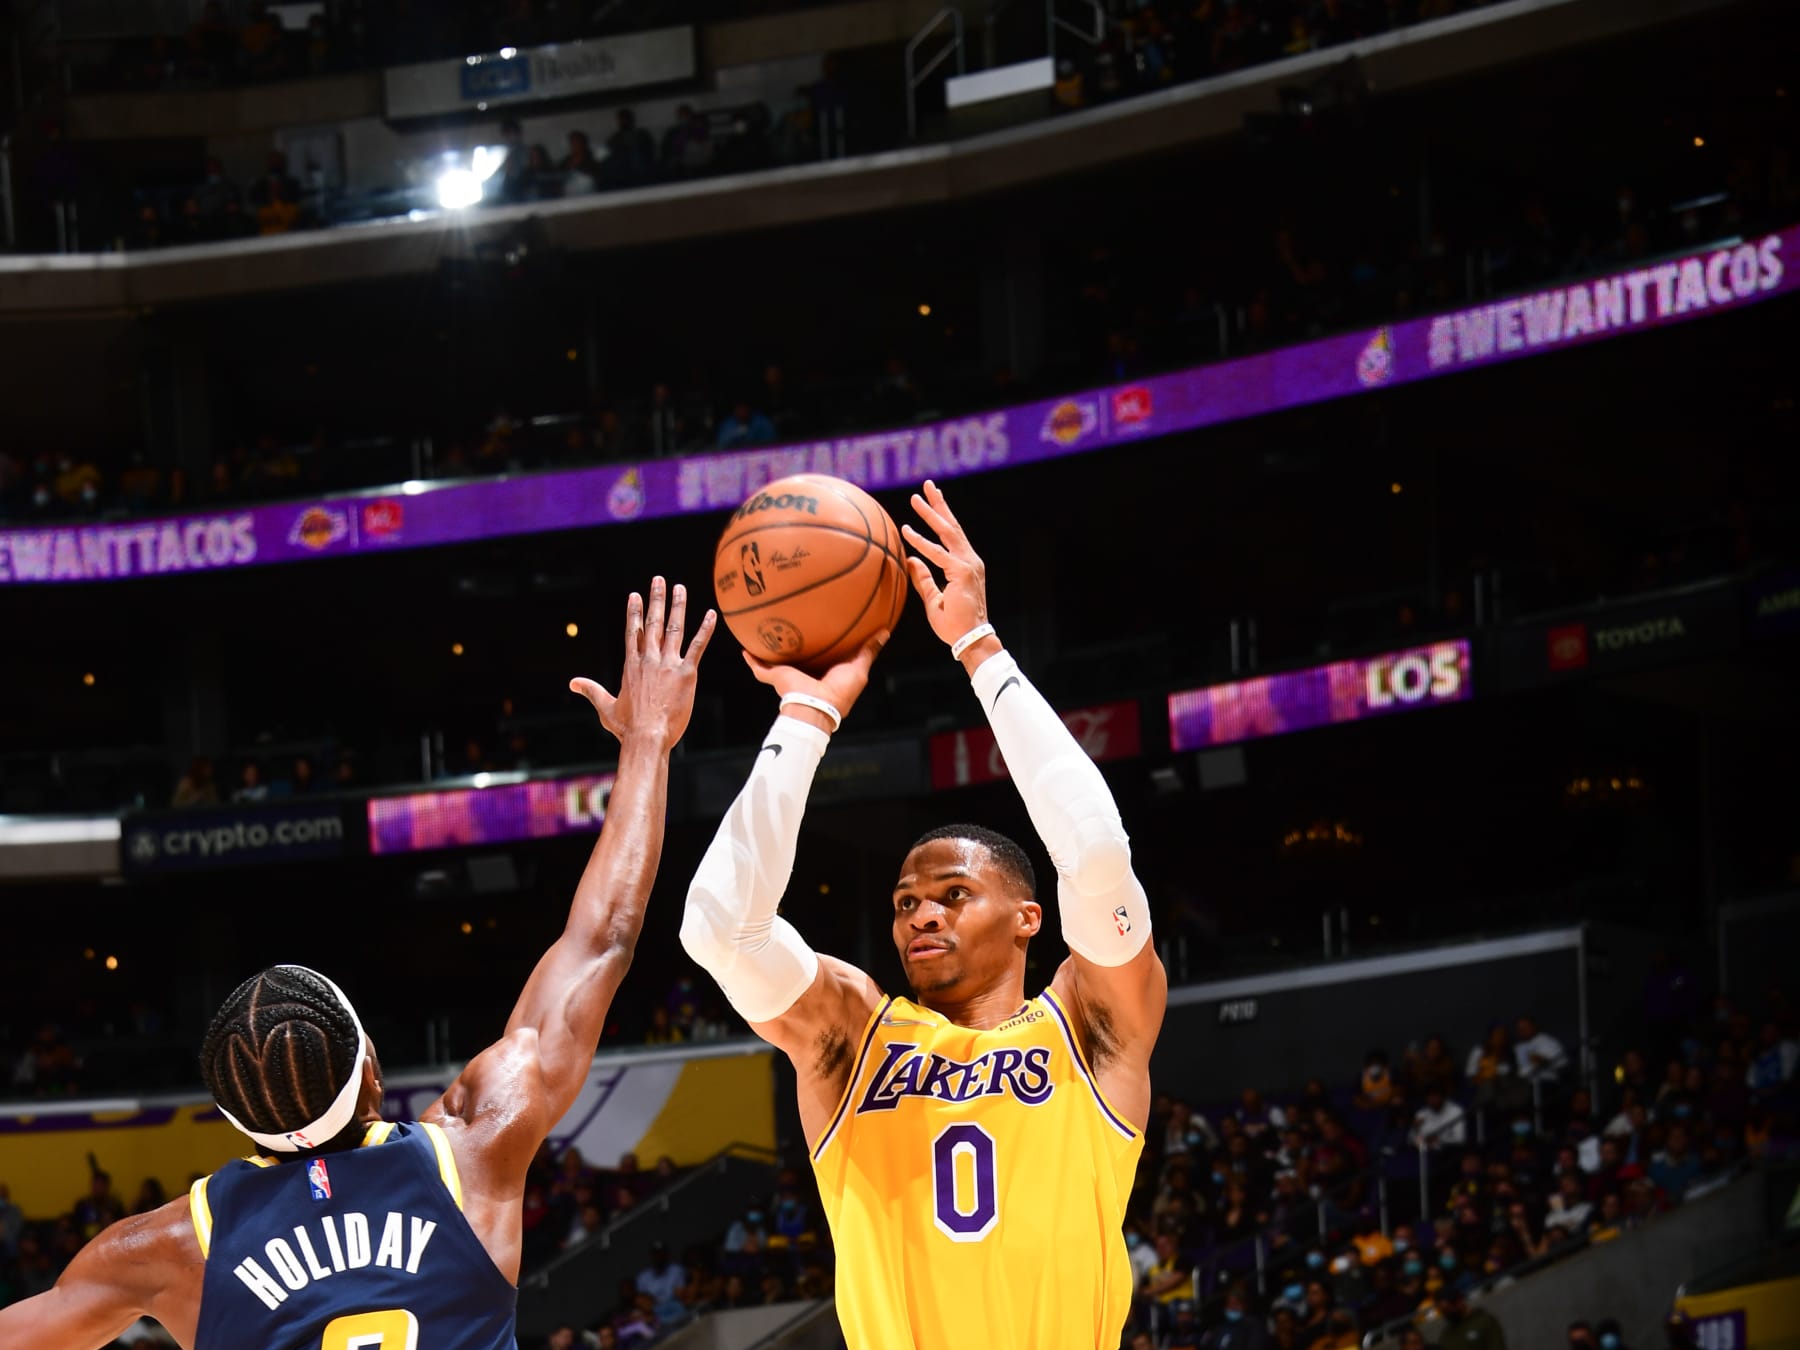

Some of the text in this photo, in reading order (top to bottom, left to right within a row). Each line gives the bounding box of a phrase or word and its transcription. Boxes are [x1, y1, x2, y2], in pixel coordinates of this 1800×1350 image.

[1427, 235, 1783, 368] #WEWANTTACOS
[1594, 617, 1686, 653] TOYOTA
[1366, 643, 1461, 709] LOS
[163, 815, 344, 857] crypto.com
[856, 1042, 1055, 1115] LAKERS
[931, 1121, 999, 1243] 0
[233, 1211, 438, 1311] HOLIDAY
